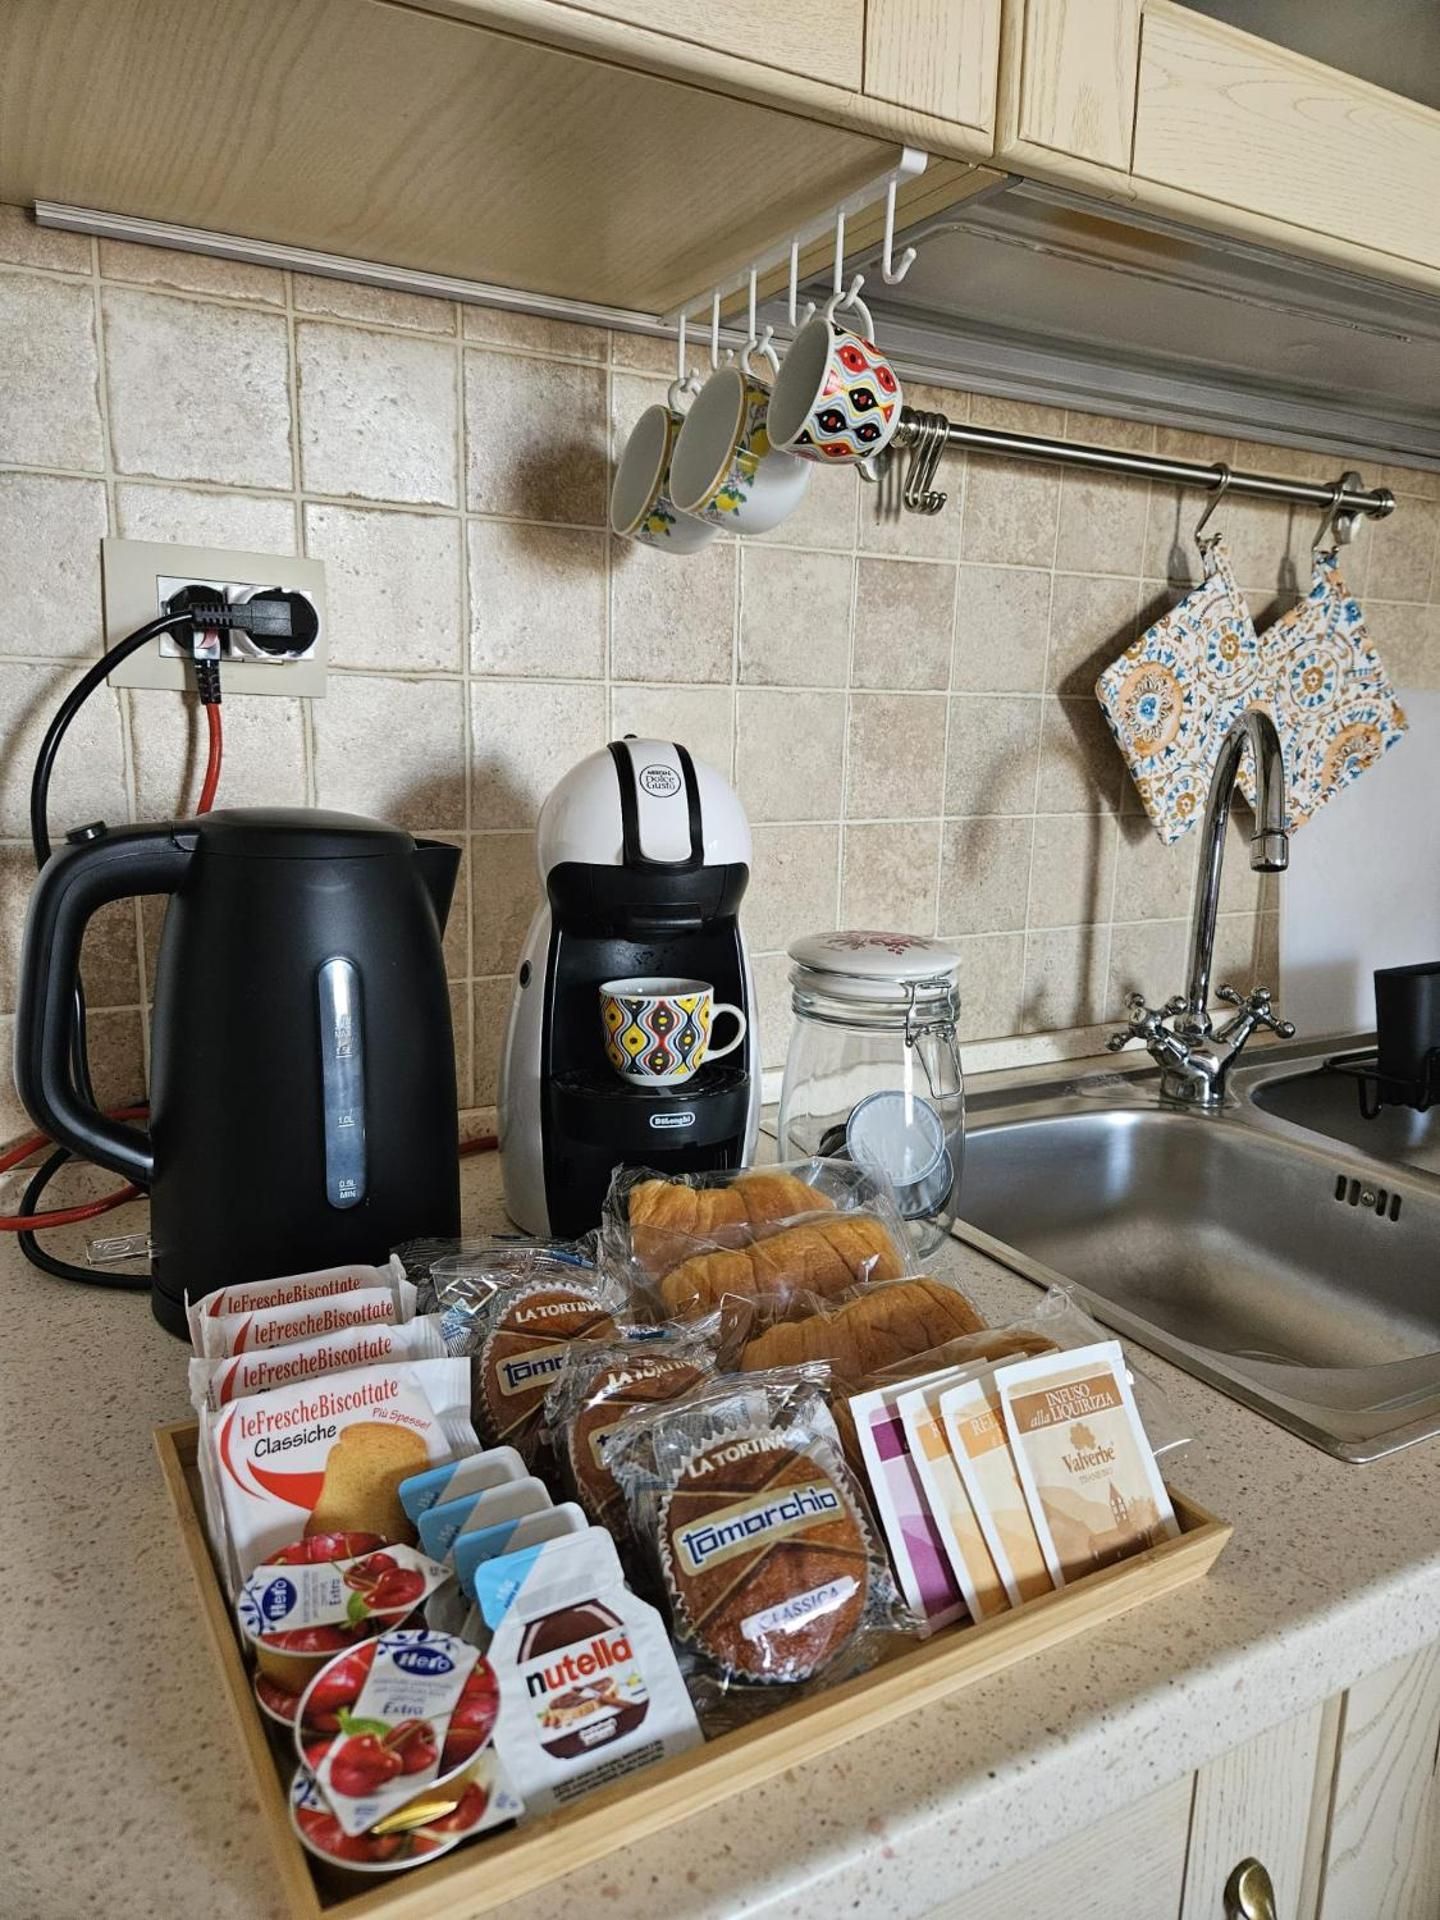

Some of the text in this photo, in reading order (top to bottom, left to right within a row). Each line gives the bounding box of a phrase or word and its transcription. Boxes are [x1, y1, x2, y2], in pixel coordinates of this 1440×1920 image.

[515, 1300, 603, 1323] LA TORTINA
[1045, 1383, 1090, 1407] INFUSO
[1049, 1391, 1114, 1421] LIQUIRIZIA
[254, 1423, 337, 1458] Classiche
[689, 1456, 714, 1478] LA
[1062, 1446, 1115, 1473] Valverbe
[683, 1489, 838, 1565] tomarchio
[270, 1580, 287, 1618] Hero
[758, 1586, 839, 1630] CLASSICA
[399, 1652, 451, 1671] Hero
[526, 1637, 633, 1698] nutella
